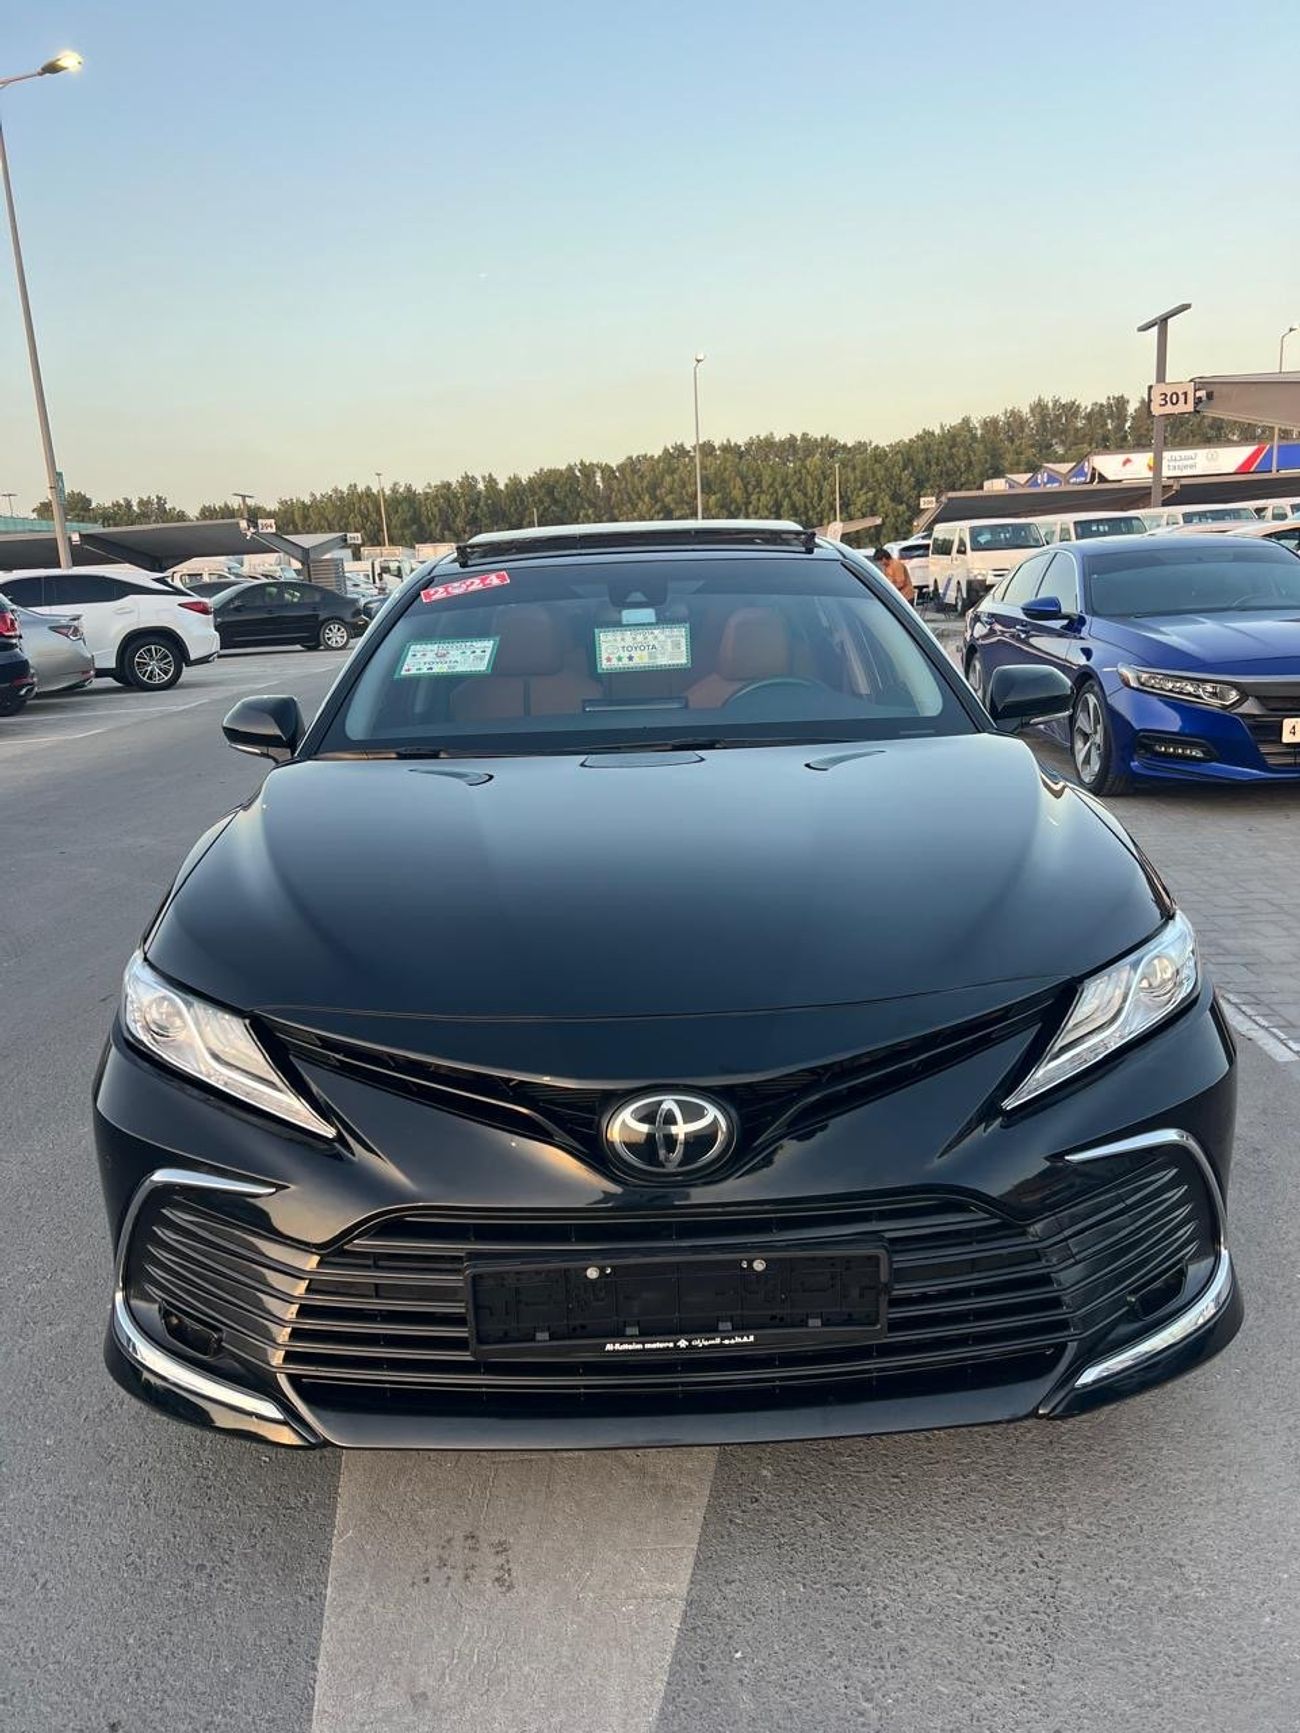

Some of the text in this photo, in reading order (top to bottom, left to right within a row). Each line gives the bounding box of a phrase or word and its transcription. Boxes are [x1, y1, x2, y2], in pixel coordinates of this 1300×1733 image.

[1158, 391, 1189, 408] 301
[1167, 452, 1198, 464] تسجيل
[1167, 463, 1198, 474] tasjeel
[427, 574, 503, 600] 2024
[620, 644, 657, 653] TOYOTA
